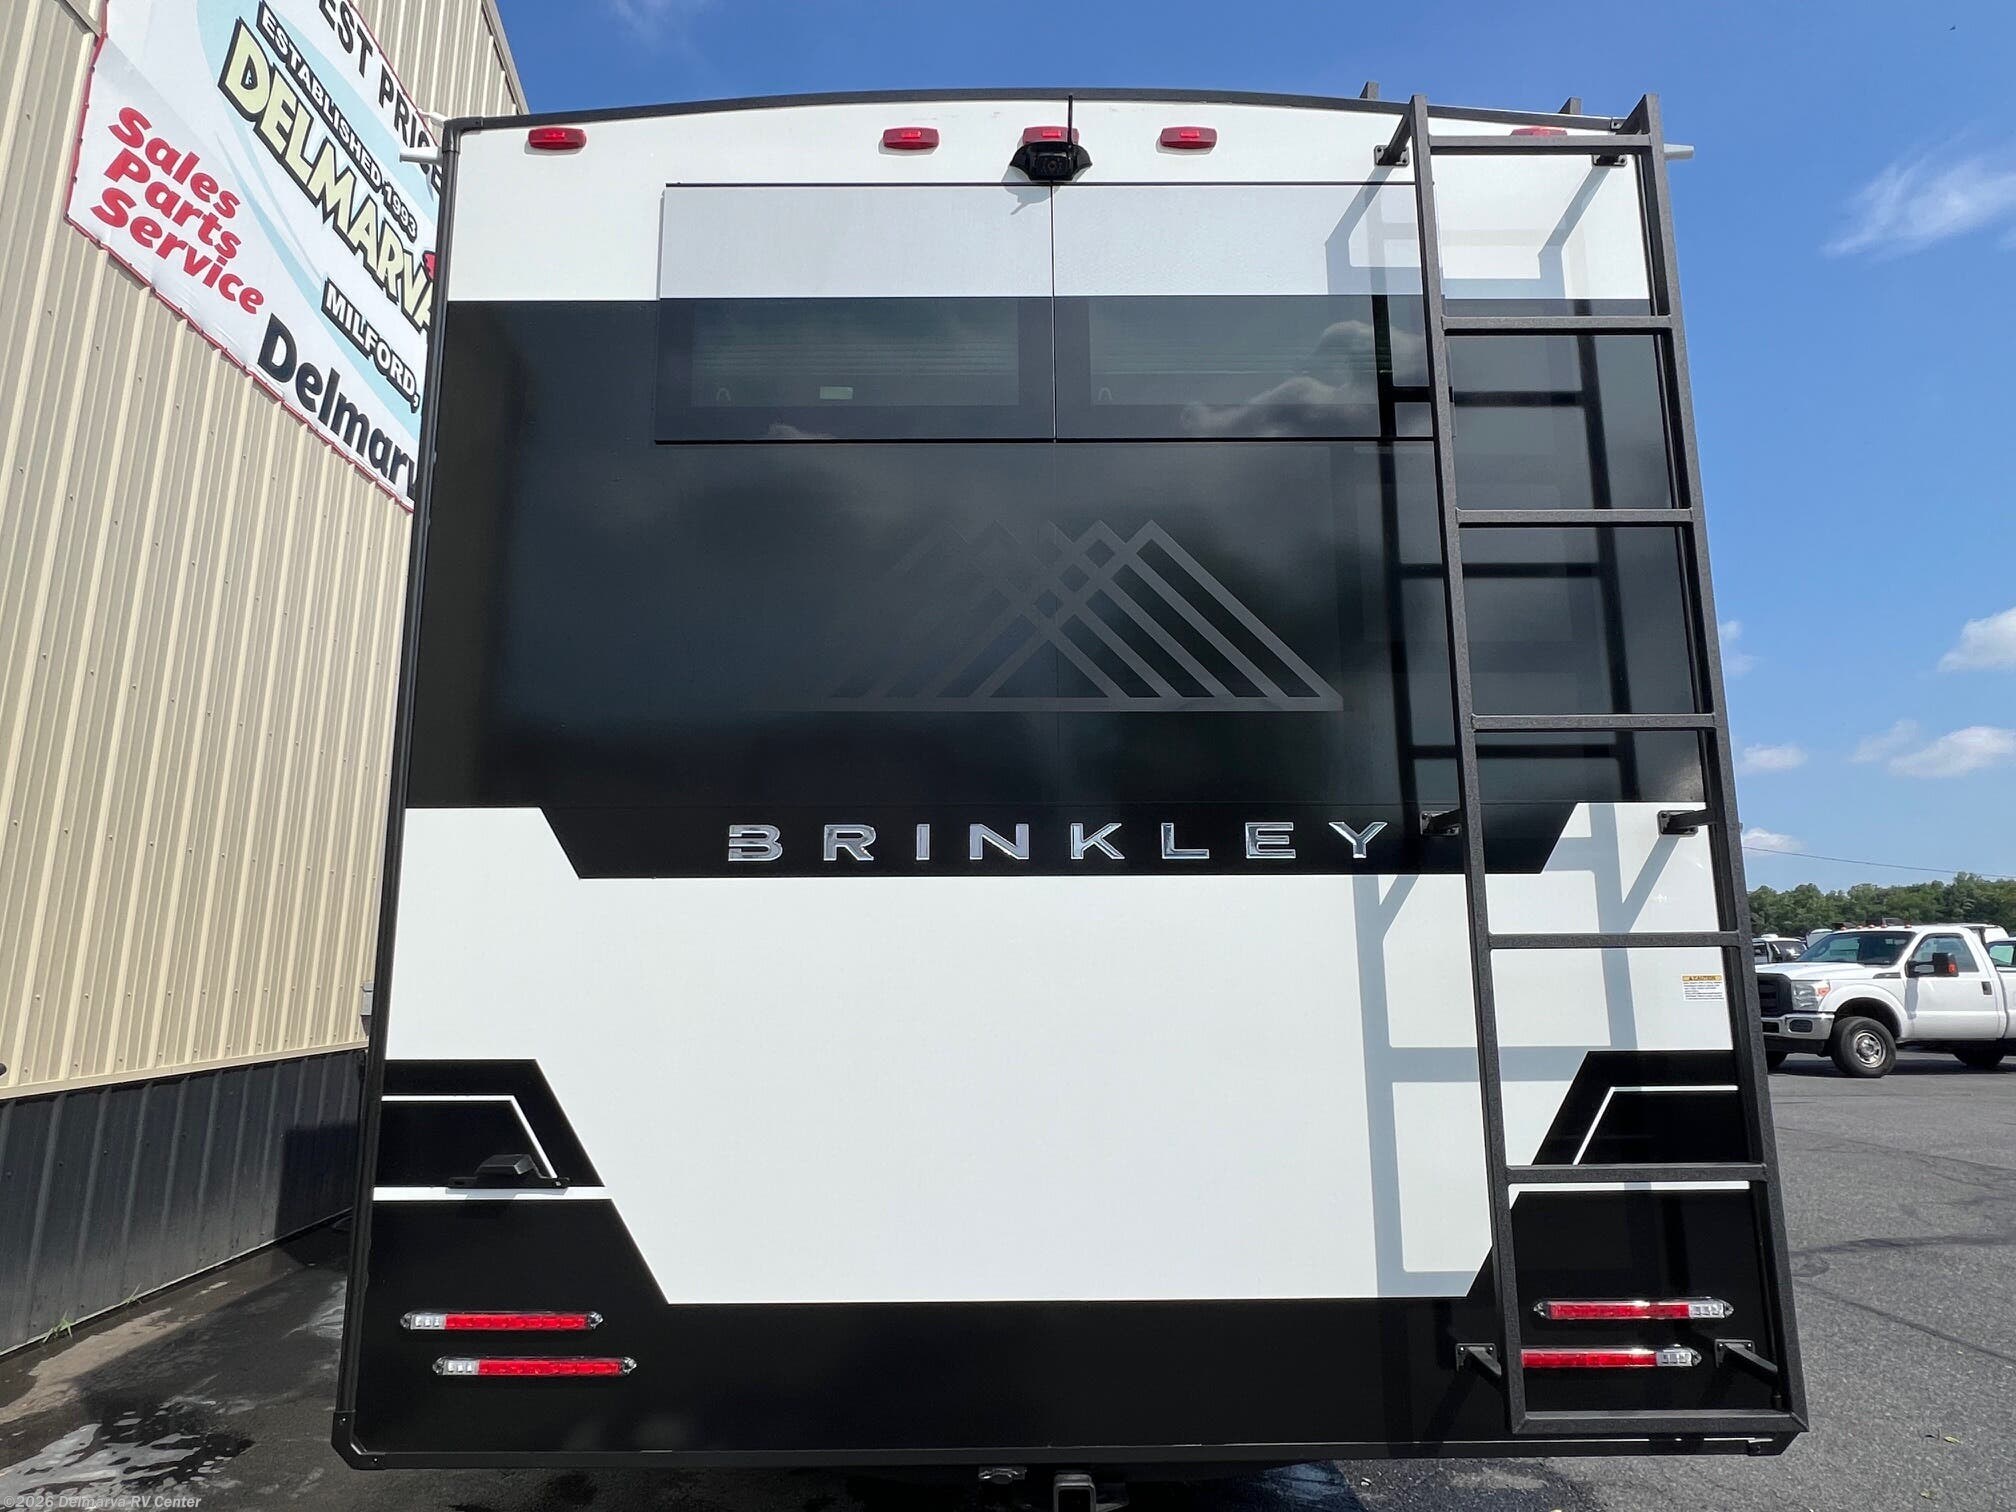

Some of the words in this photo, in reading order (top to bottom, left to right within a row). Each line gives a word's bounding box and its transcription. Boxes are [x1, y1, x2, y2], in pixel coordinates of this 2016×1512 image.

[109, 107, 240, 218] Sales
[257, 2, 384, 190] ESTABLISHED
[382, 180, 417, 241] 1993
[90, 187, 264, 314] Service
[104, 148, 241, 259] Parts
[321, 277, 421, 413] MILFORD,
[727, 821, 1389, 862] BRINKLEY
